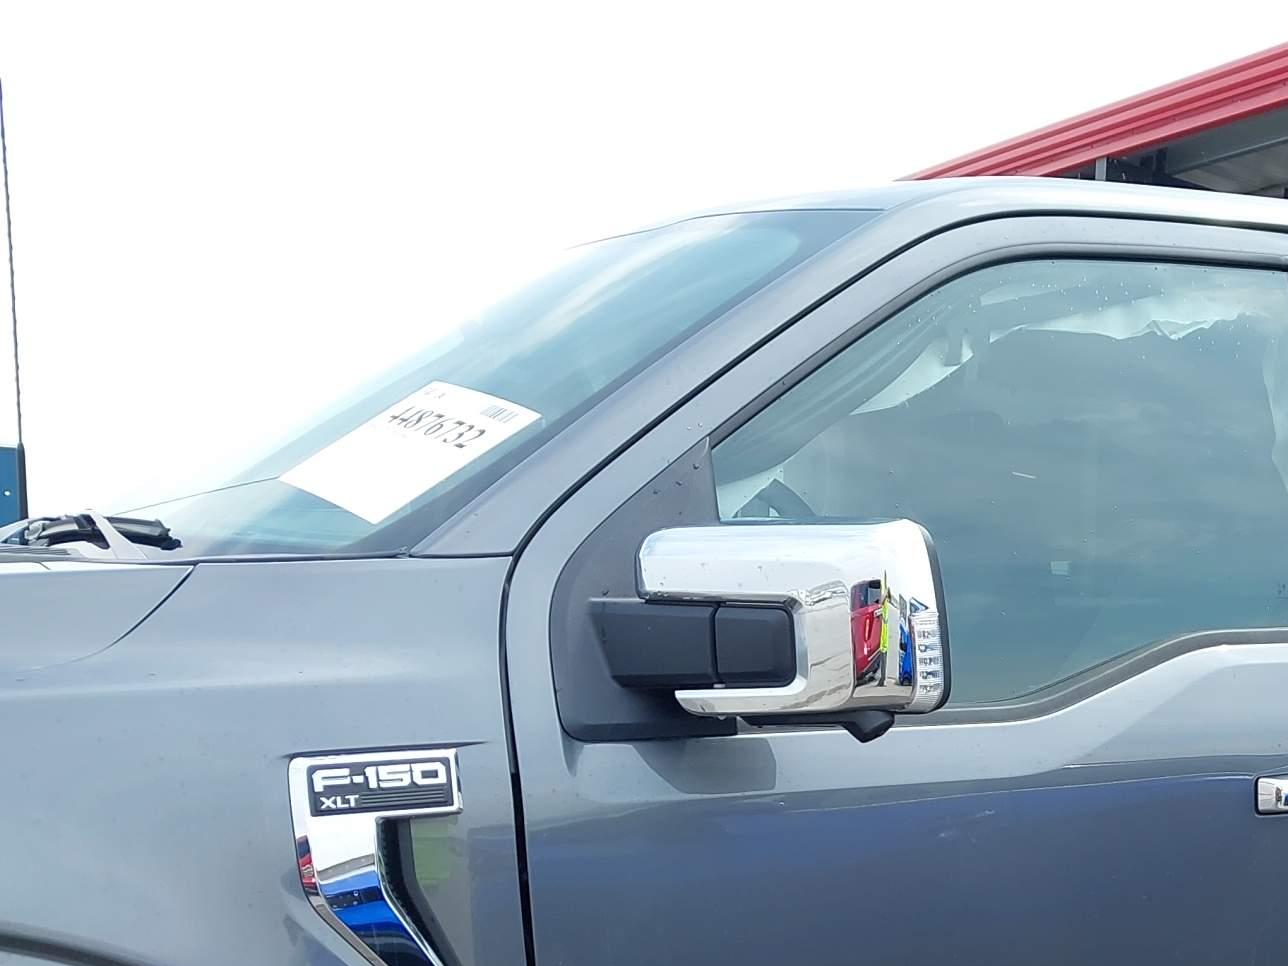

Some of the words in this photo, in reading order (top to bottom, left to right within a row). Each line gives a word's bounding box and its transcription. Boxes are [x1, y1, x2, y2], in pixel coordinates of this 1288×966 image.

[388, 406, 487, 449] 44876732
[311, 761, 447, 793] F-150
[319, 794, 360, 810] XLT
